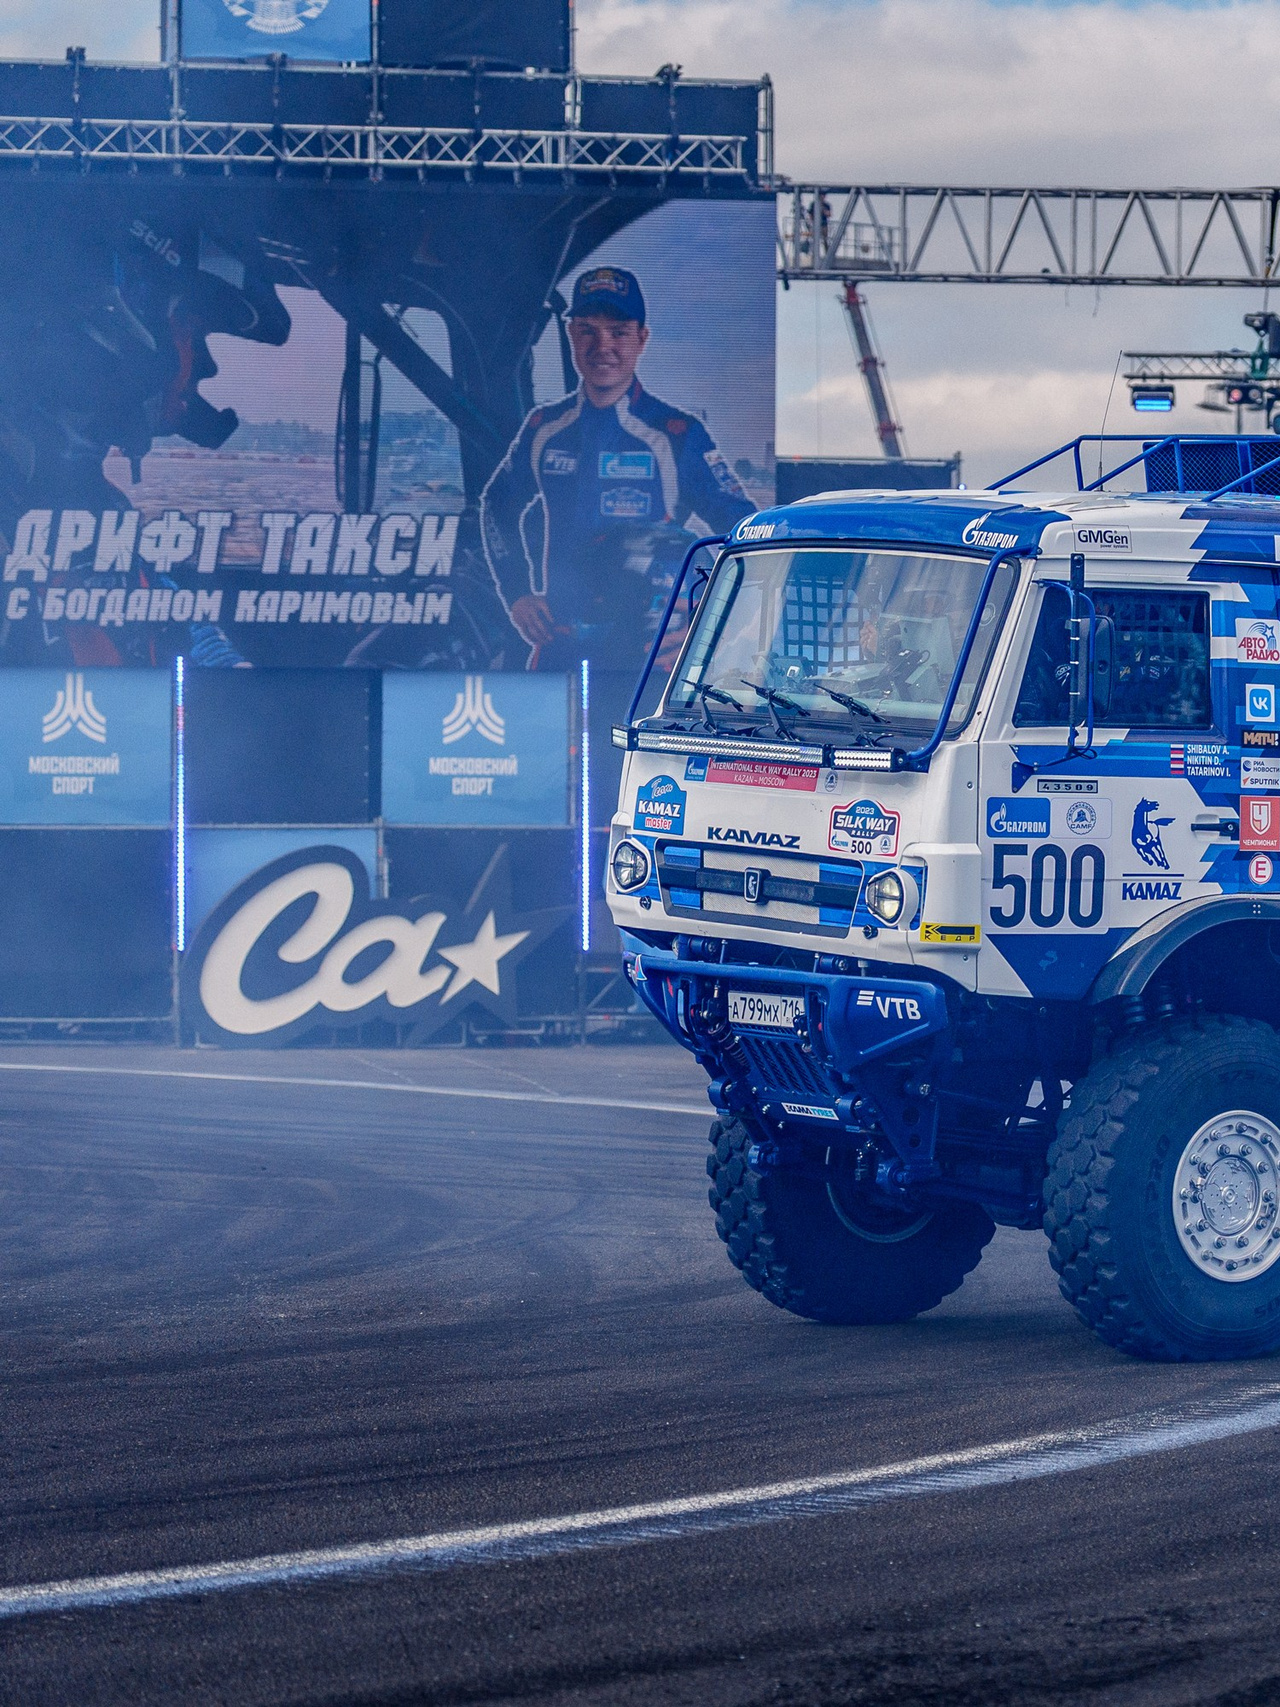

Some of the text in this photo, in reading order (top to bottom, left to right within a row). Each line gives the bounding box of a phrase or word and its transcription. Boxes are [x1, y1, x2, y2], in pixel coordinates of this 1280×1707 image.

[976, 531, 1018, 549] ГАЗПРОМ
[1077, 529, 1129, 545] GMGen
[3, 509, 460, 582] ДРИФТ ТАКСИ
[7, 588, 453, 627] С БОГДАНОМ КАРИМОВЫМ
[1238, 637, 1266, 650] АВТО
[1246, 648, 1280, 662] РАДИО
[1252, 697, 1269, 710] VK
[1243, 731, 1279, 746] МАТЧ!
[1187, 744, 1230, 755] SHIBALOV A.
[29, 753, 121, 776] МОСКОВСКИЙ
[429, 754, 518, 776] МОСКОВСКИЙ
[1187, 756, 1221, 766] NIKITIN D.
[711, 761, 754, 774] INTERNATIONAL
[754, 766, 768, 775] SILK
[768, 767, 783, 776] WAY
[782, 768, 802, 778] RALLY
[802, 768, 817, 779] 2023
[1187, 766, 1226, 777] TATARINOV
[52, 776, 95, 795] СПОРТ
[451, 777, 494, 796] СПОРТ
[734, 774, 754, 784] KAZAN
[758, 777, 786, 787] MOSCOW
[1041, 783, 1094, 792] 43509
[637, 800, 681, 818] KAMAZ
[855, 806, 875, 815] 2023
[645, 816, 673, 830] master
[835, 814, 894, 832] SILK WAY
[1007, 821, 1047, 833] GAZPROM
[707, 827, 801, 849] KAMAZ
[1242, 839, 1278, 847] ЧЕМПИОНАТ
[851, 840, 872, 855] 500
[1255, 861, 1267, 878] E
[990, 843, 1106, 928] 500
[1122, 882, 1182, 900] KAMAZ
[924, 934, 976, 942] КЕДР
[782, 999, 801, 1018] 716
[876, 996, 922, 1021] VTB
